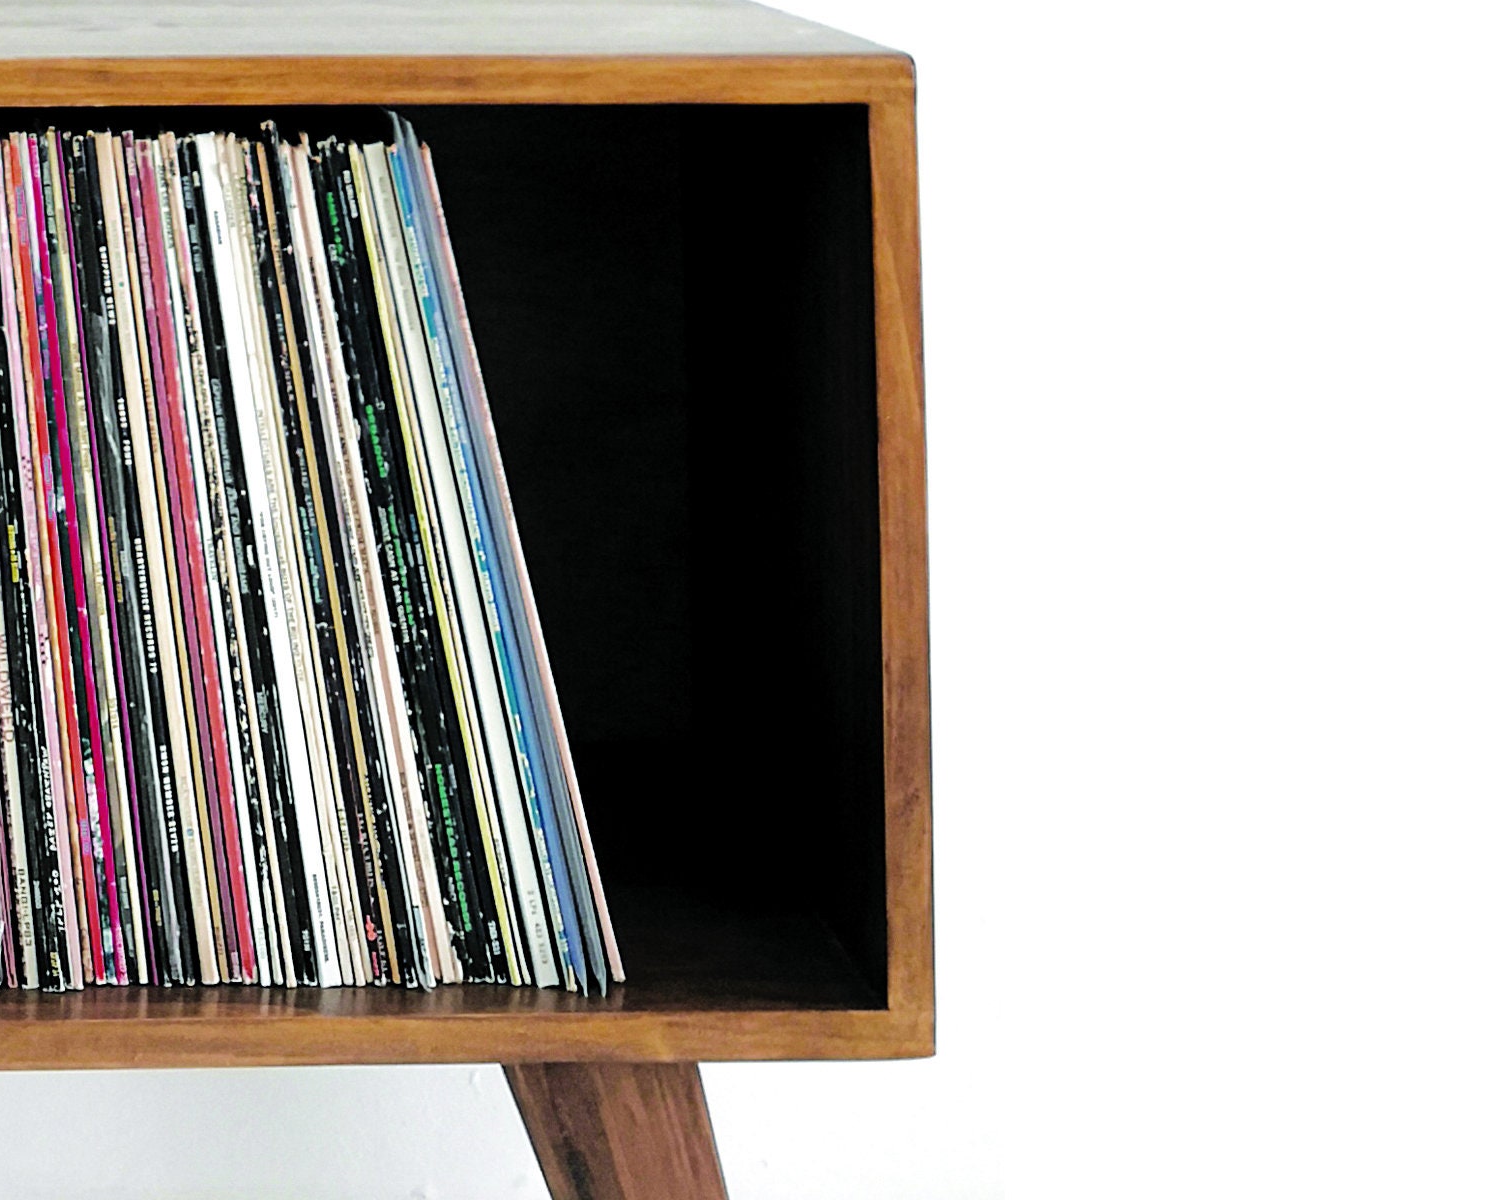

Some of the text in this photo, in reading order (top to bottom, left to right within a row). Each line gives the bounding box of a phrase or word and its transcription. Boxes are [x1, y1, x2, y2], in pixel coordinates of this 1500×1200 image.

[99, 246, 116, 326] SHIPPING NEWS
[267, 478, 277, 494] ARE
[269, 497, 279, 512] THE
[384, 544, 396, 568] CASH
[133, 538, 150, 610] QUARTERSTICK
[142, 614, 156, 661] RECORDS
[283, 592, 293, 606] OF
[286, 608, 296, 624] THE
[434, 764, 472, 932] HOMESTEAD RECORDS
